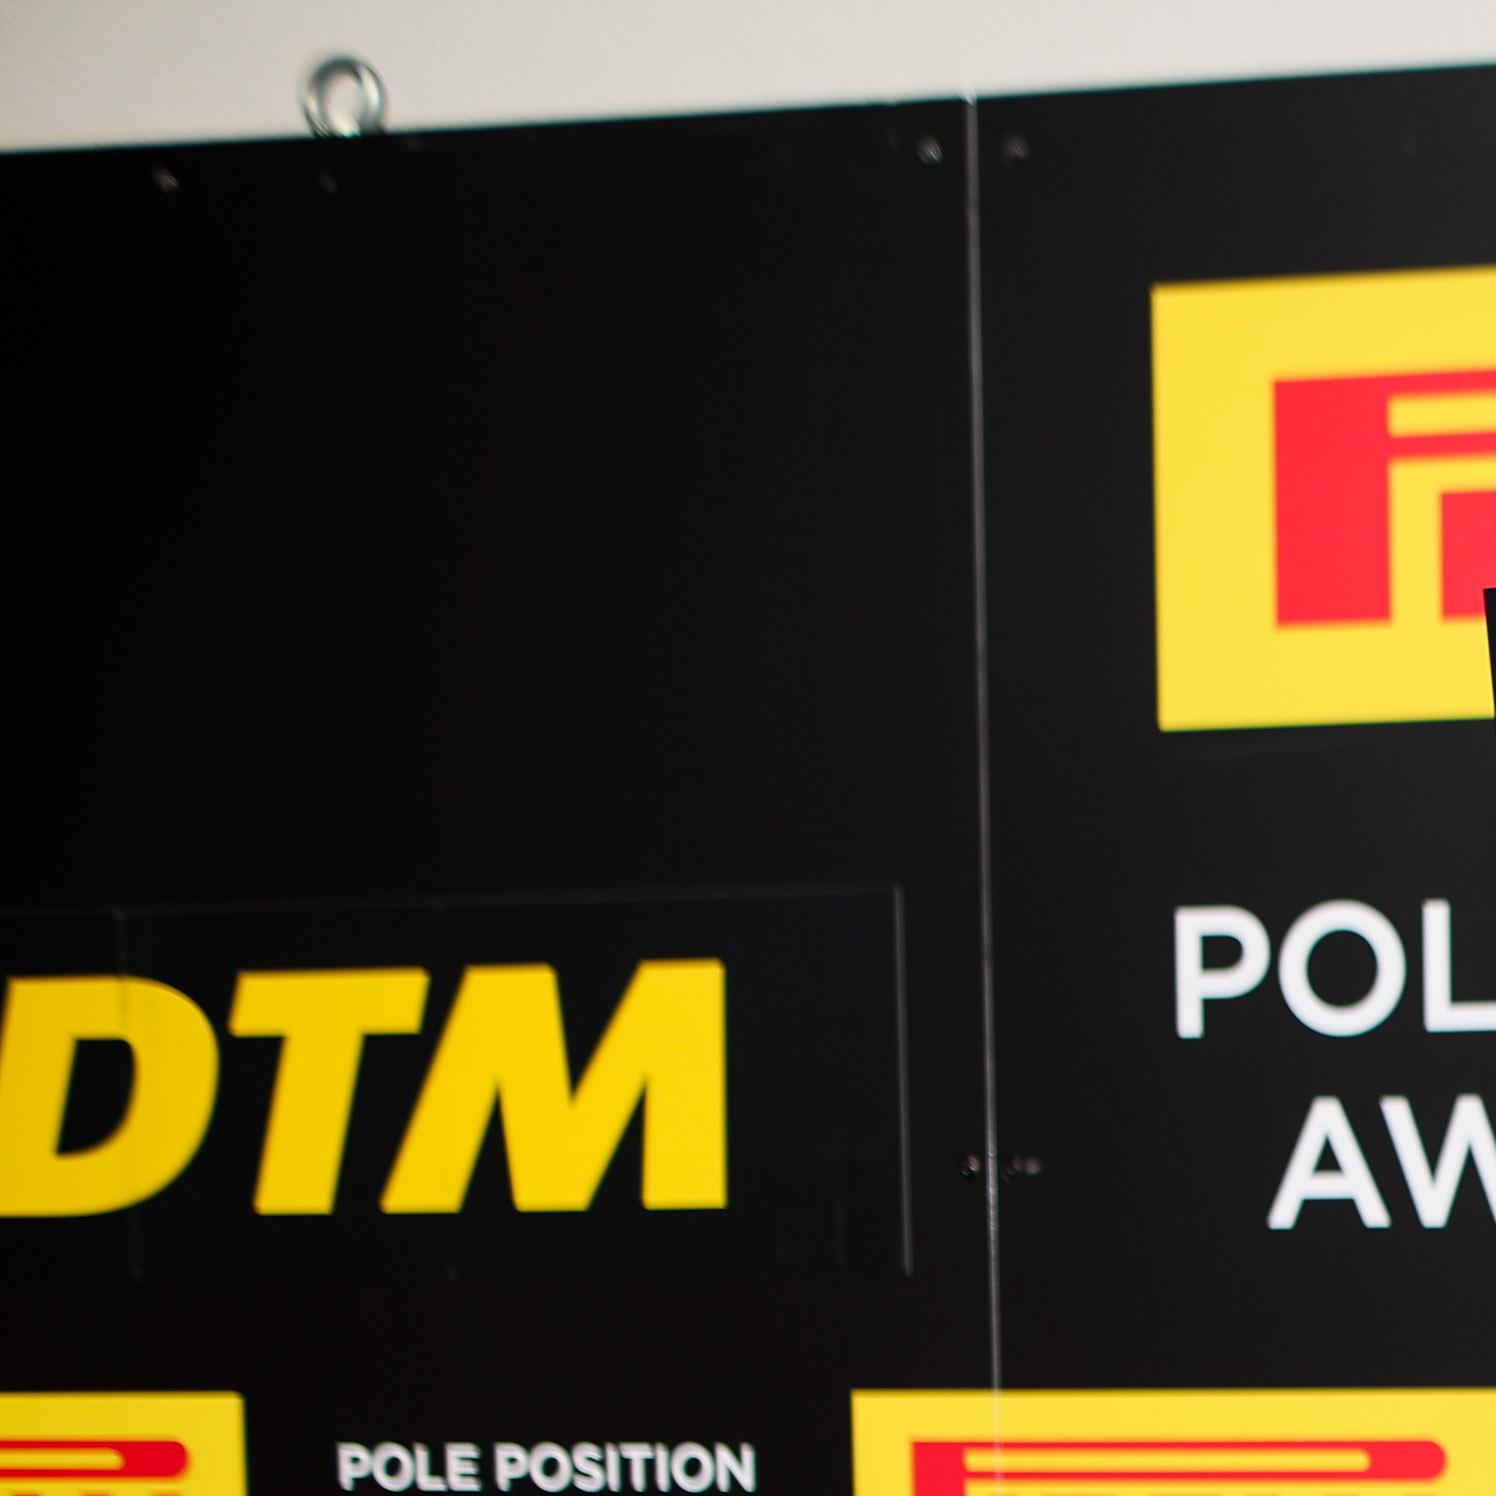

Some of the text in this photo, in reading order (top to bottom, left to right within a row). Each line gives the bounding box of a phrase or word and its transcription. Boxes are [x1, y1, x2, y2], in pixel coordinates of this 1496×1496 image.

[0, 957, 727, 1218] DTM
[337, 1441, 756, 1493] POLE POSITION
